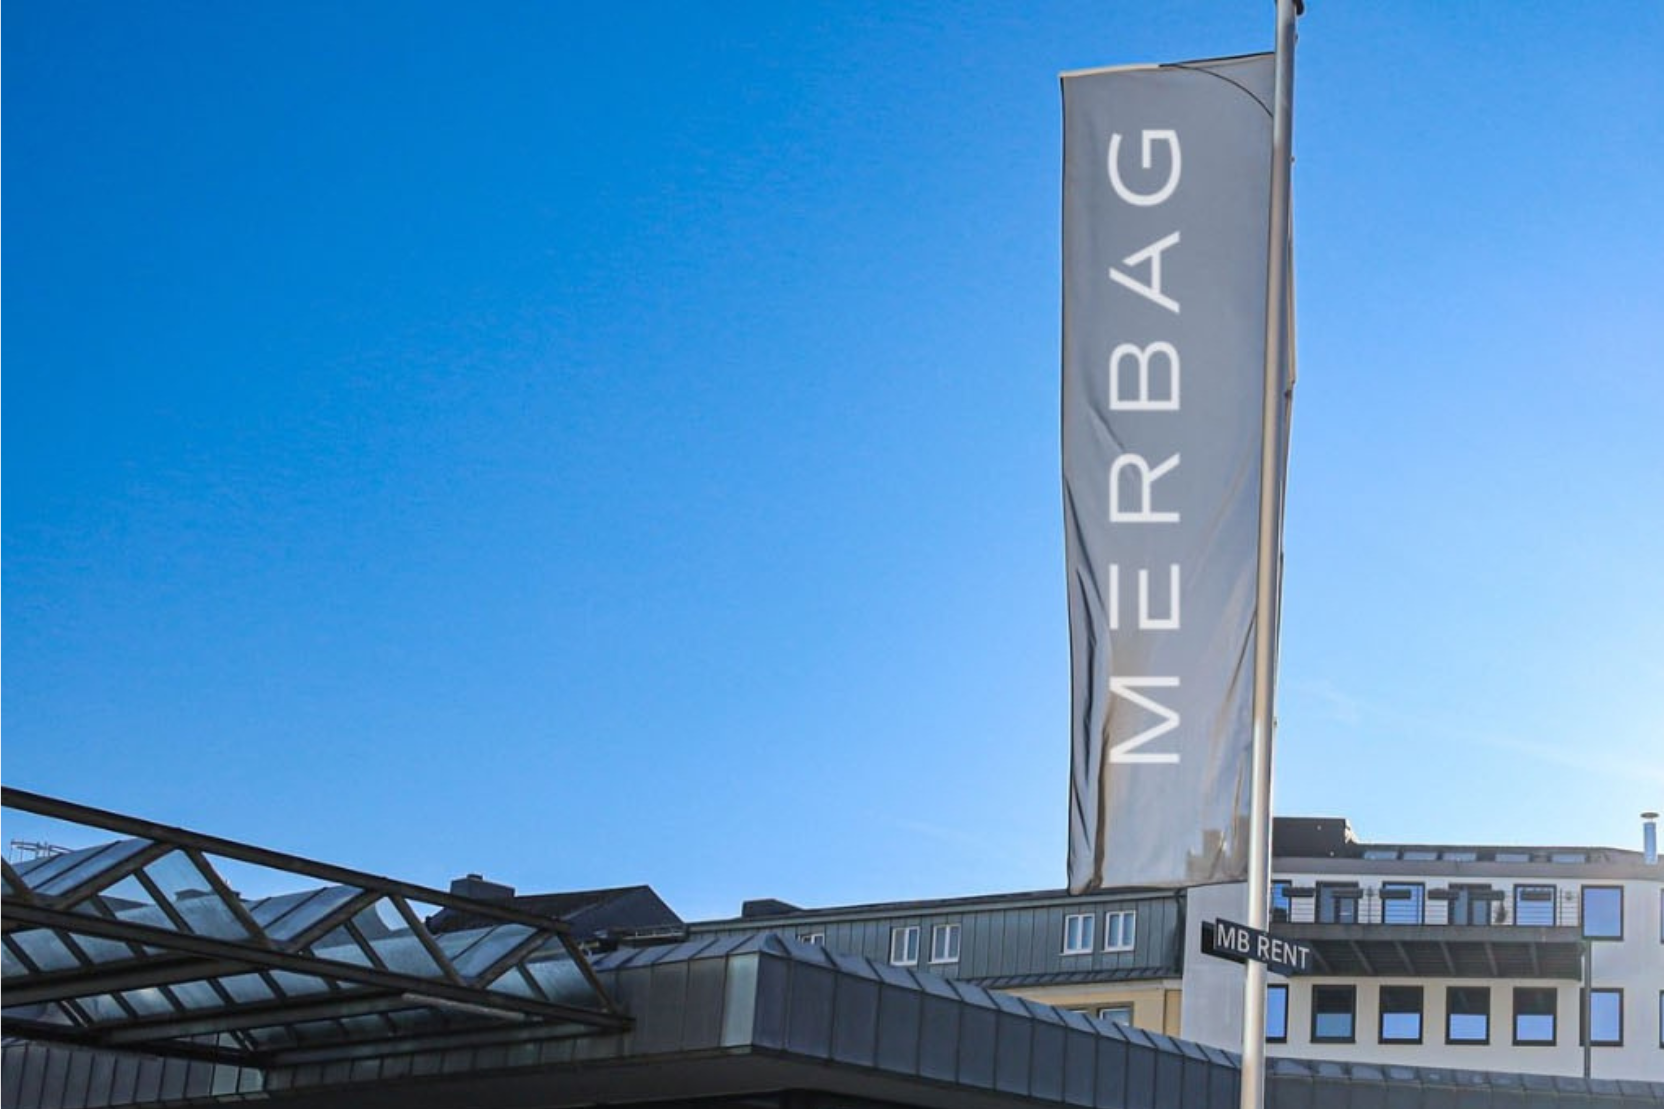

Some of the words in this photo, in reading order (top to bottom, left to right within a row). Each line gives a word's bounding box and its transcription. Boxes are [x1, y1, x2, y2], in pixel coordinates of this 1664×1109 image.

[1107, 128, 1182, 765] MERBAG
[1217, 923, 1251, 954] MB
[1257, 935, 1311, 970] RENT
